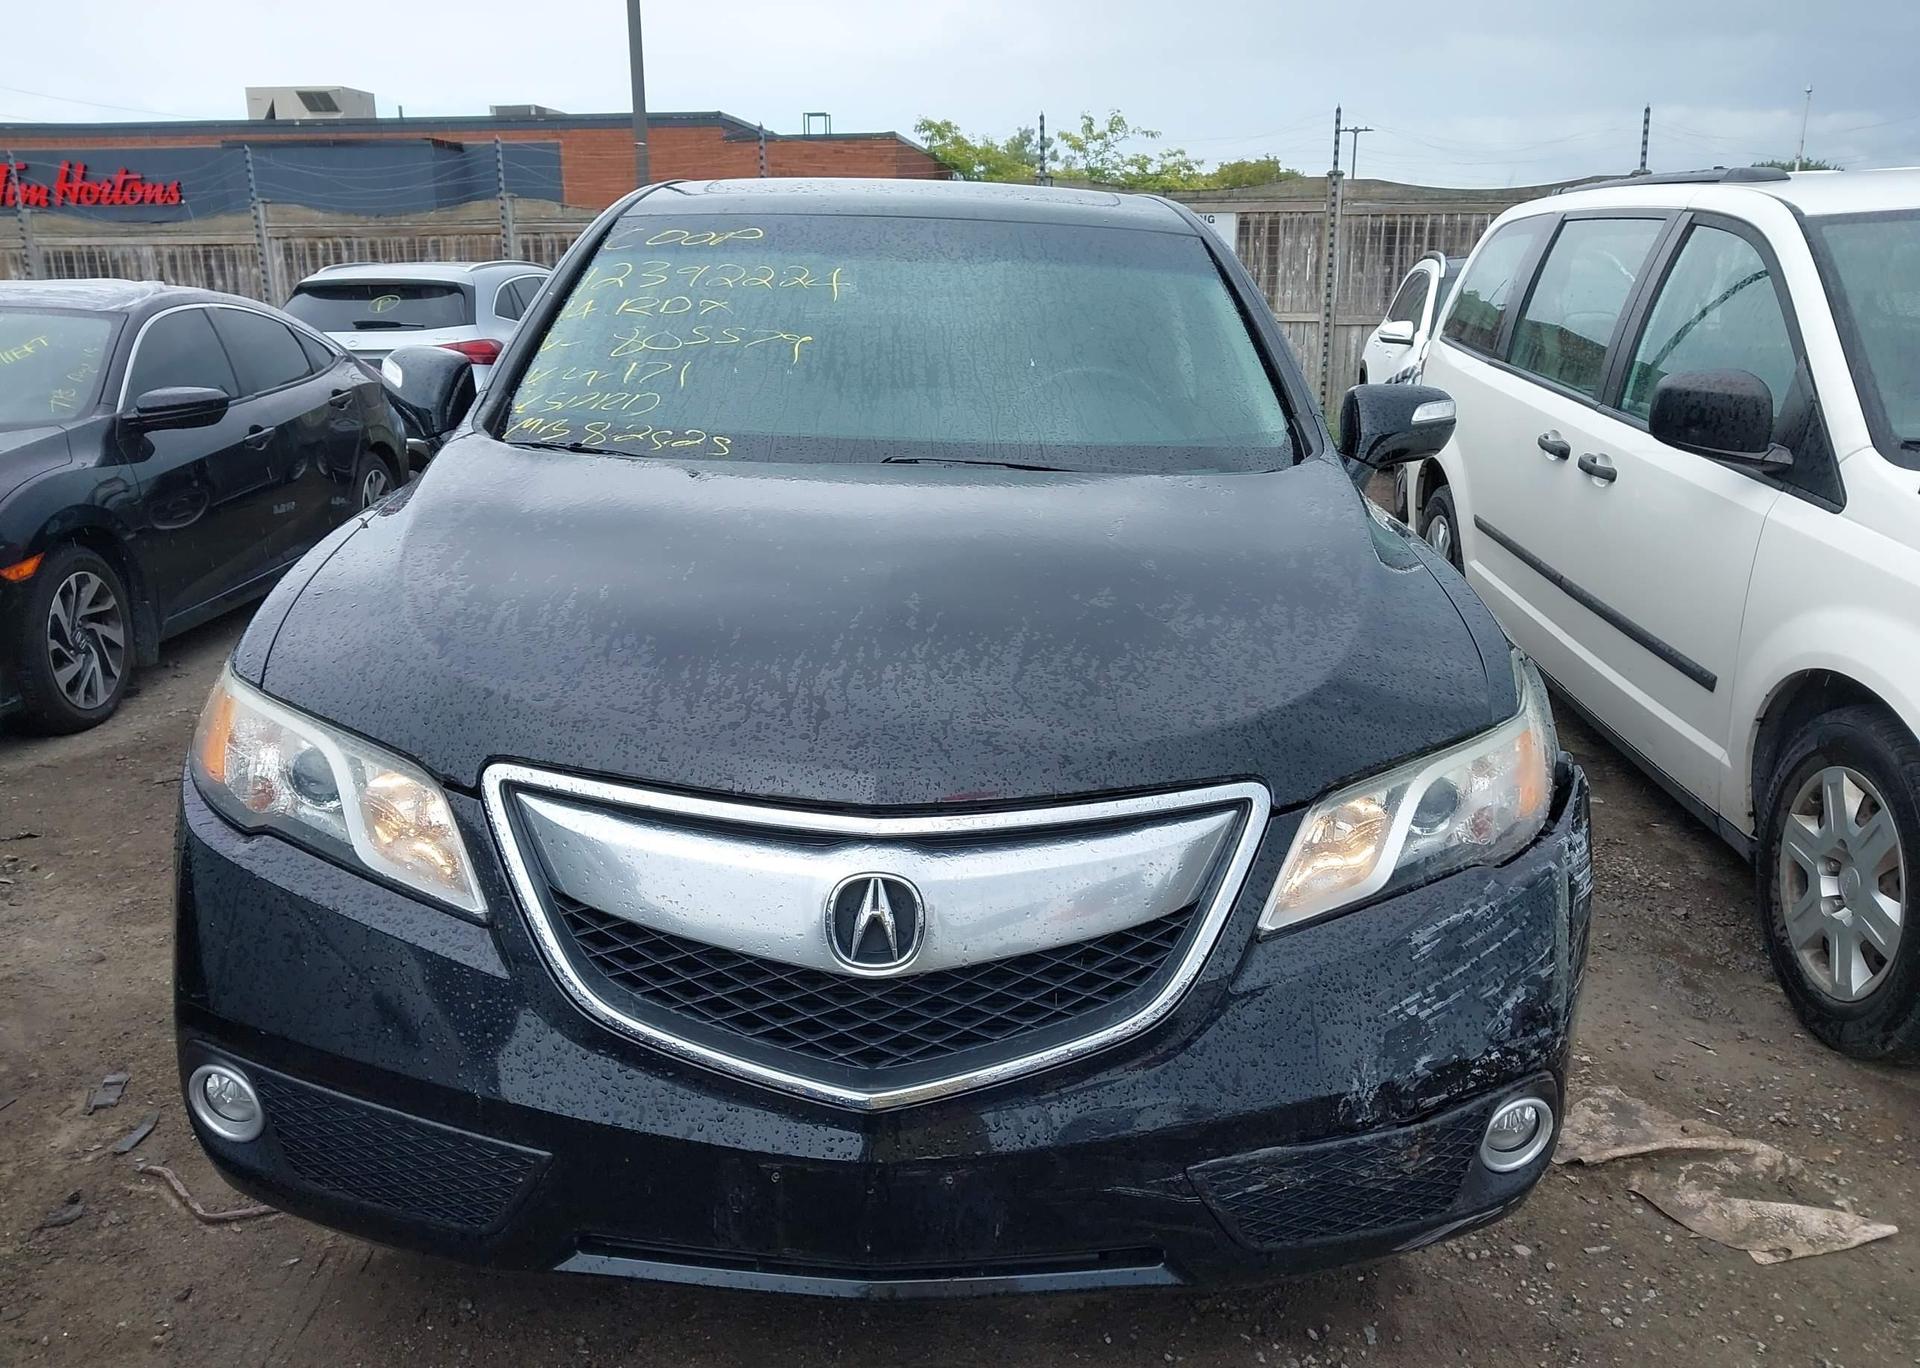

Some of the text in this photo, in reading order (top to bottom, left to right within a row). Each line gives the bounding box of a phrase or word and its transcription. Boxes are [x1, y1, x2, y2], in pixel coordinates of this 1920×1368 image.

[54, 160, 181, 207] Hortons
[602, 228, 764, 250] COOP
[615, 296, 734, 317] RDX
